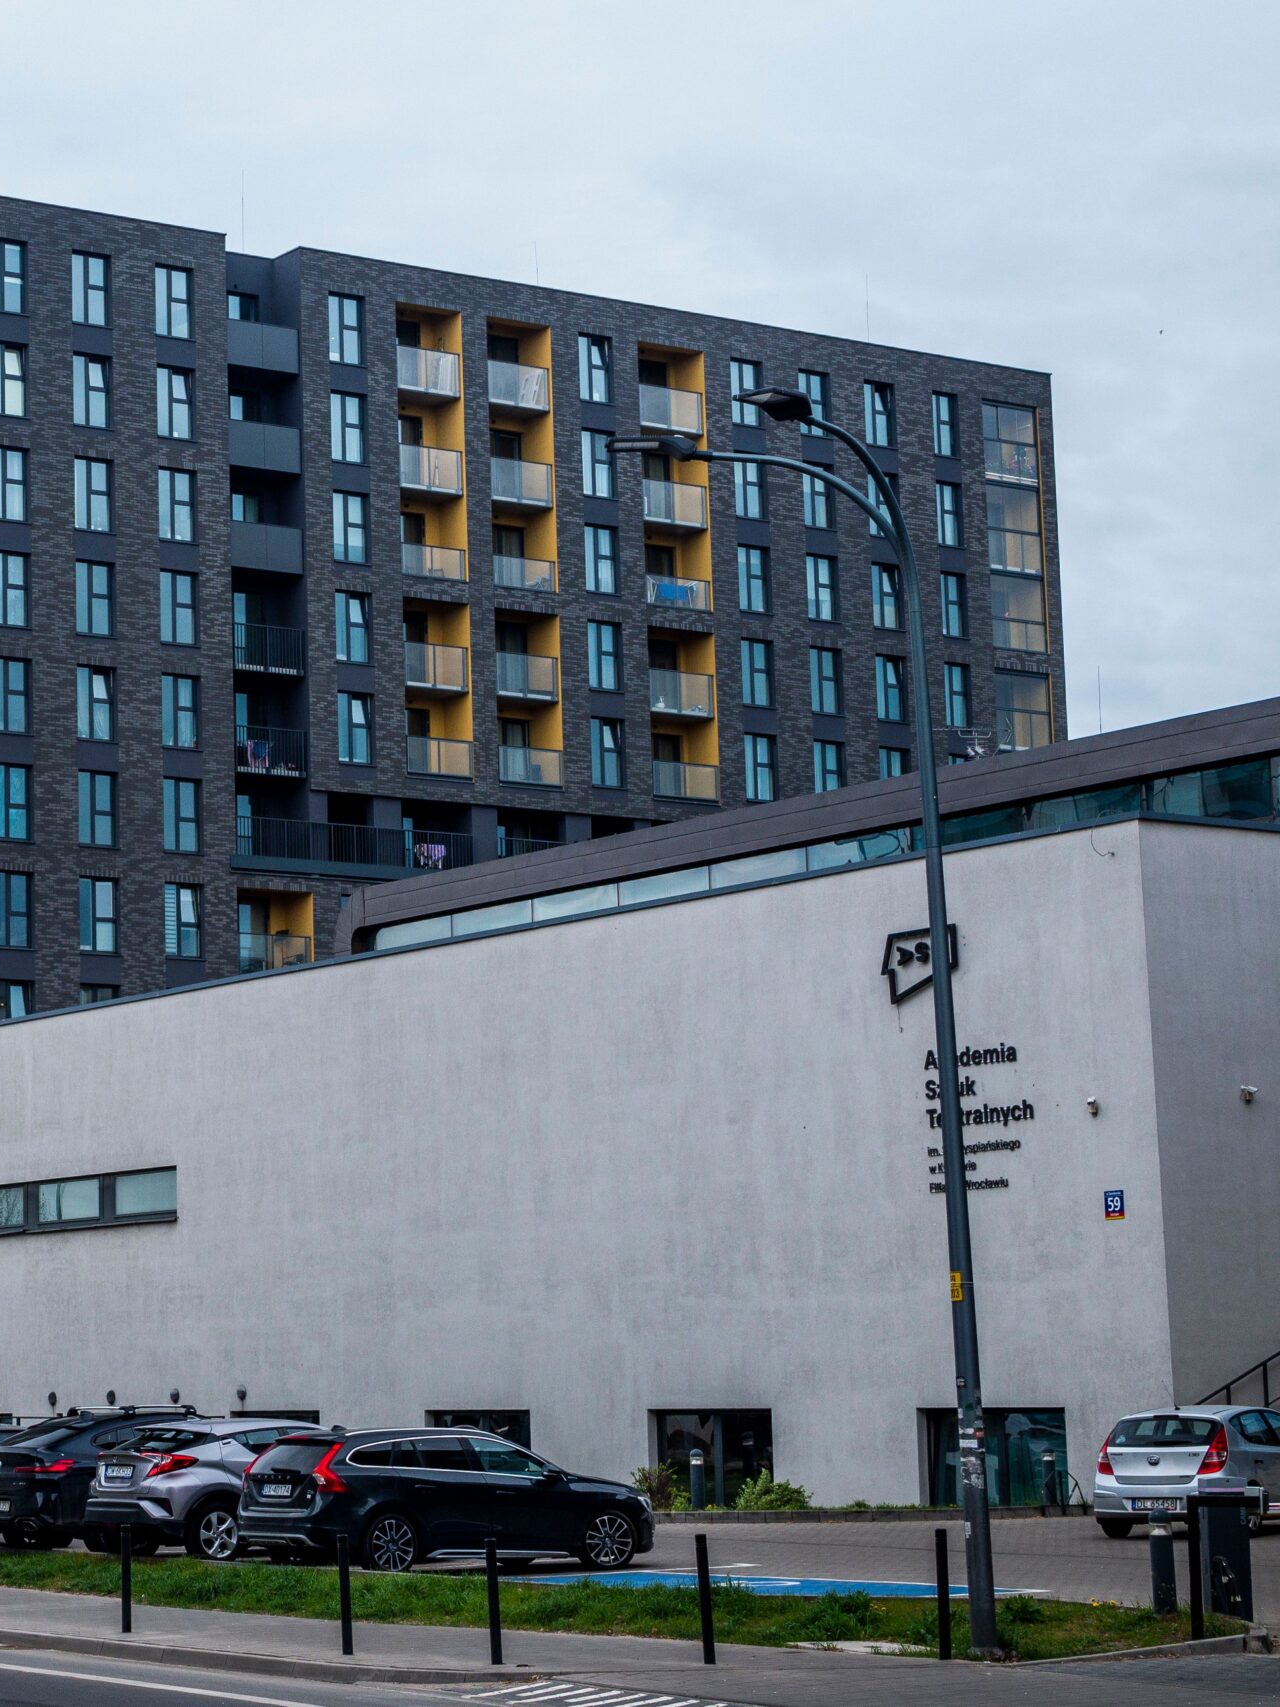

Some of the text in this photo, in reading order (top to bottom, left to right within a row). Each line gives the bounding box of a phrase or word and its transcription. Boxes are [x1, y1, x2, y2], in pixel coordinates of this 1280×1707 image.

[924, 1042, 1017, 1070] Ademia
[962, 1139, 1021, 1155] yspiańskiego
[1107, 1196, 1121, 1211] 59
[1136, 1498, 1175, 1509] DL 65458
